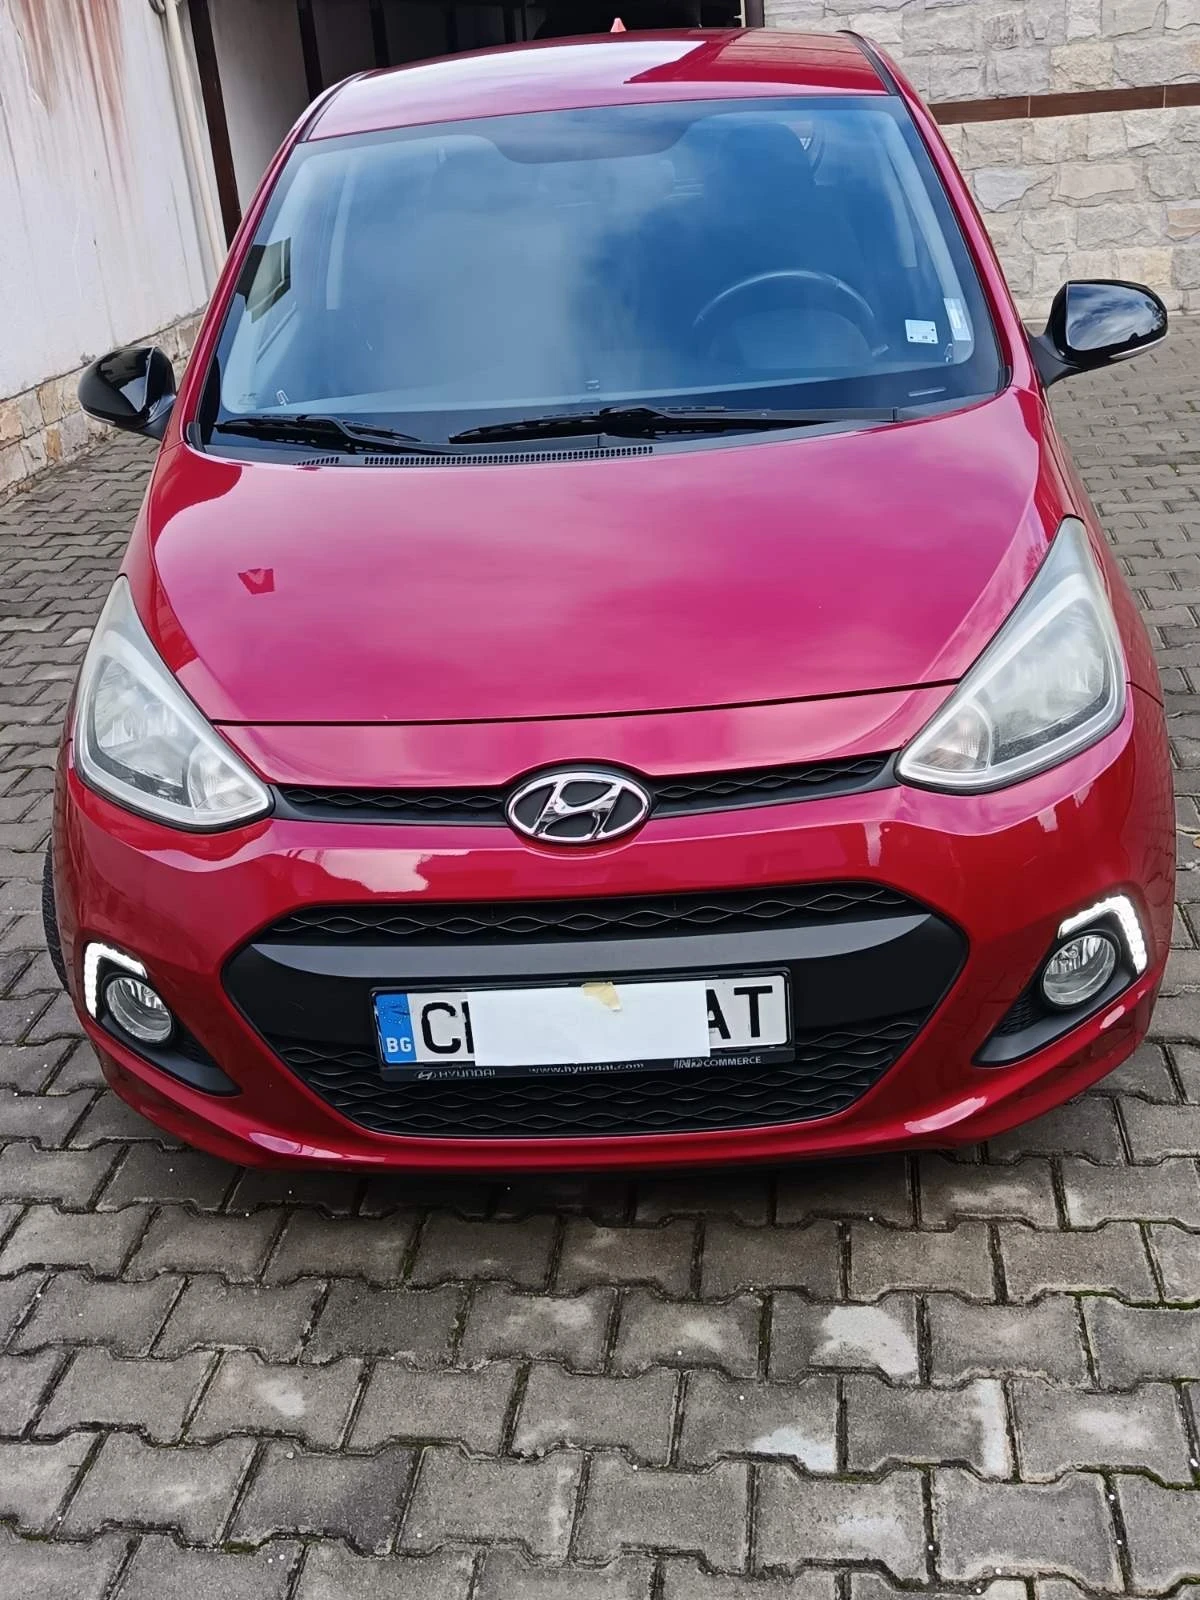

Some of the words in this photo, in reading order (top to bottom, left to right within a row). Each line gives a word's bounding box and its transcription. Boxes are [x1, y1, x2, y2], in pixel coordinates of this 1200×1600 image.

[421, 1000, 475, 1055] C
[705, 985, 773, 1040] AT
[385, 1037, 412, 1053] BG
[439, 1068, 496, 1079] HYUNDAI
